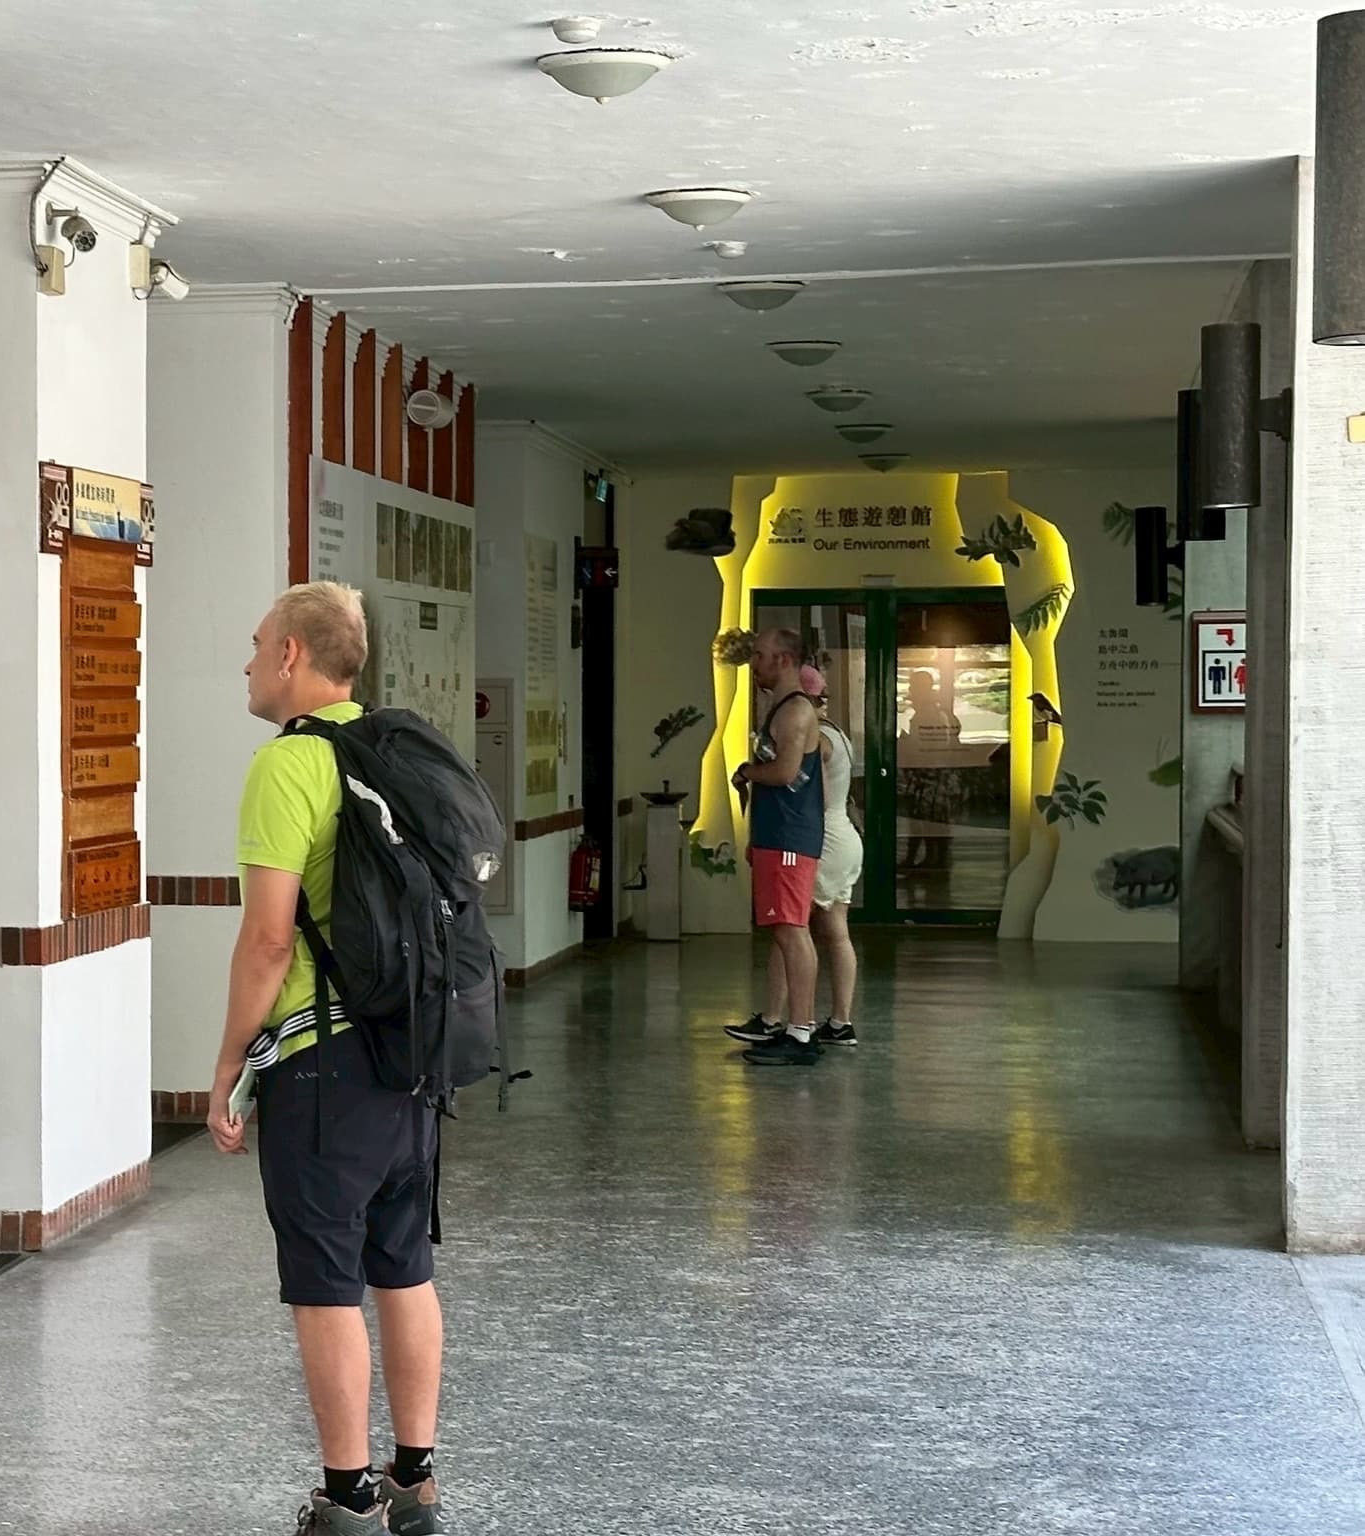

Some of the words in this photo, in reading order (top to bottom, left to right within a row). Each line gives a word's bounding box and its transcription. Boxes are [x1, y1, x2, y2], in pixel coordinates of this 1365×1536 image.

[814, 505, 932, 528] 生態遊憩館
[813, 538, 839, 551] Our
[843, 536, 931, 551] Environment
